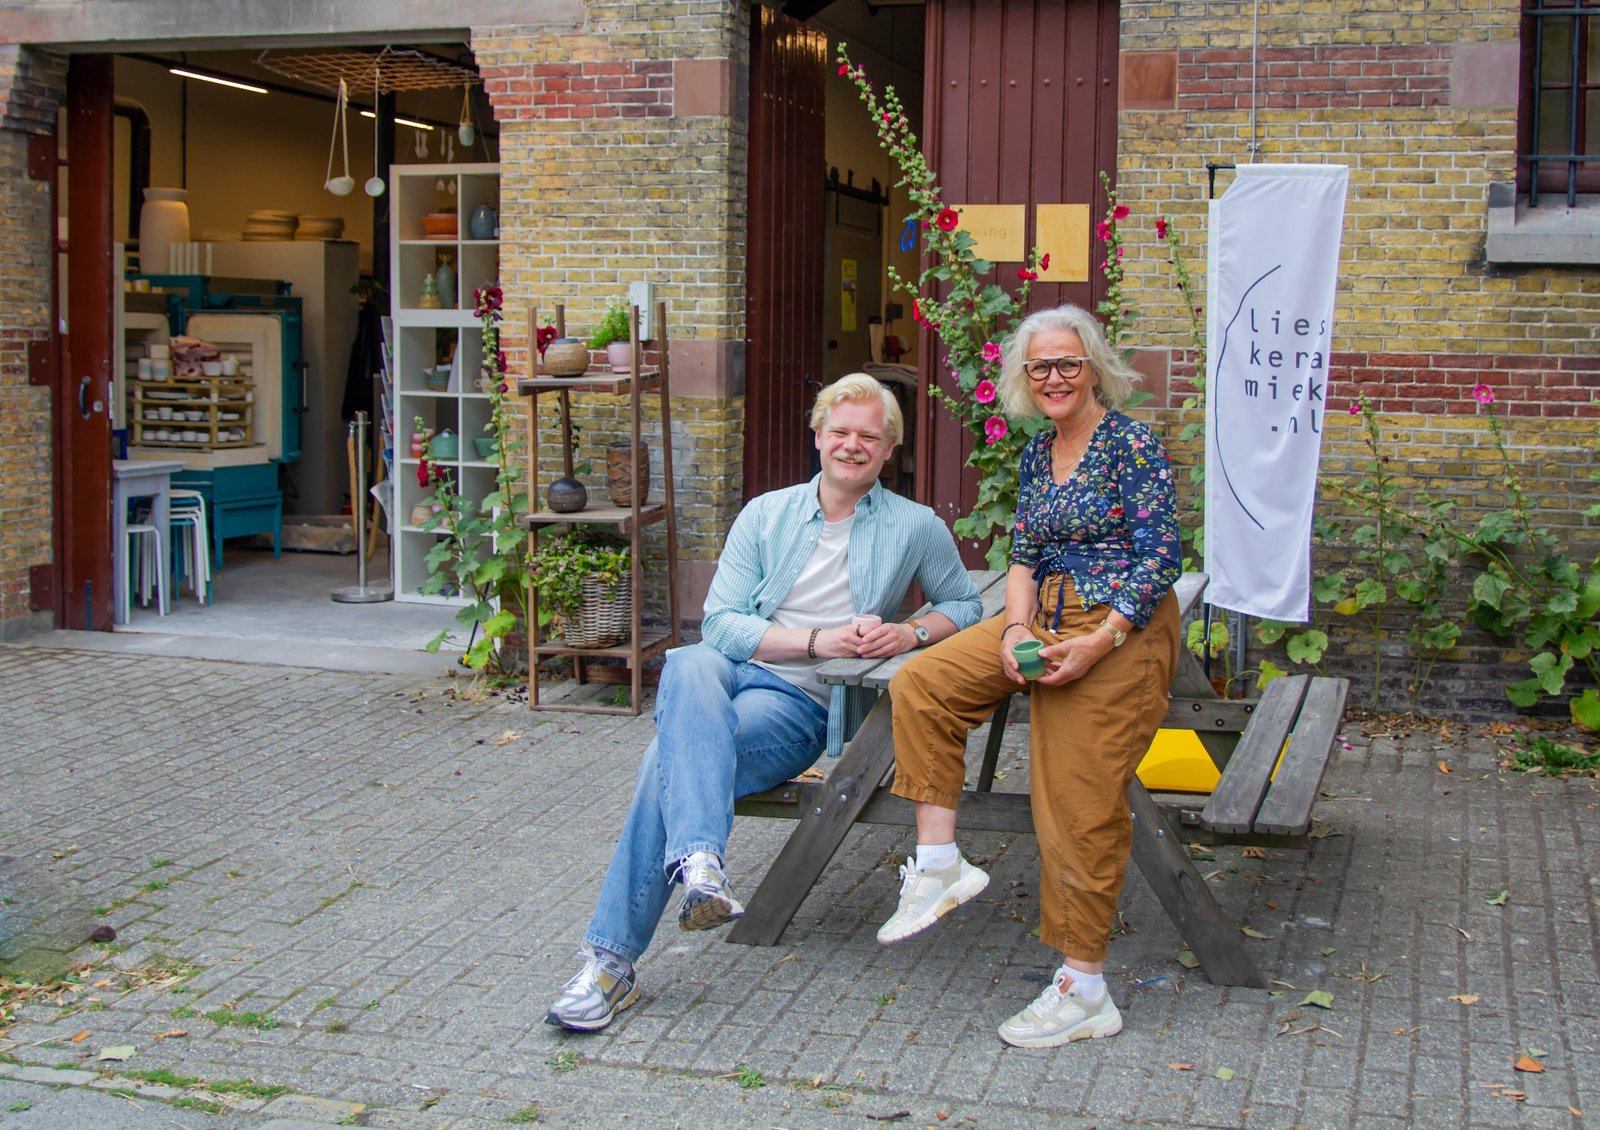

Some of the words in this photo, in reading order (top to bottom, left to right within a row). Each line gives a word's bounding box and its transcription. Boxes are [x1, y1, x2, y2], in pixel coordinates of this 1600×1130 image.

[1250, 308, 1326, 336] lies
[1249, 340, 1323, 369] kera
[1244, 375, 1323, 402] miek
[1271, 409, 1320, 434] .nl
